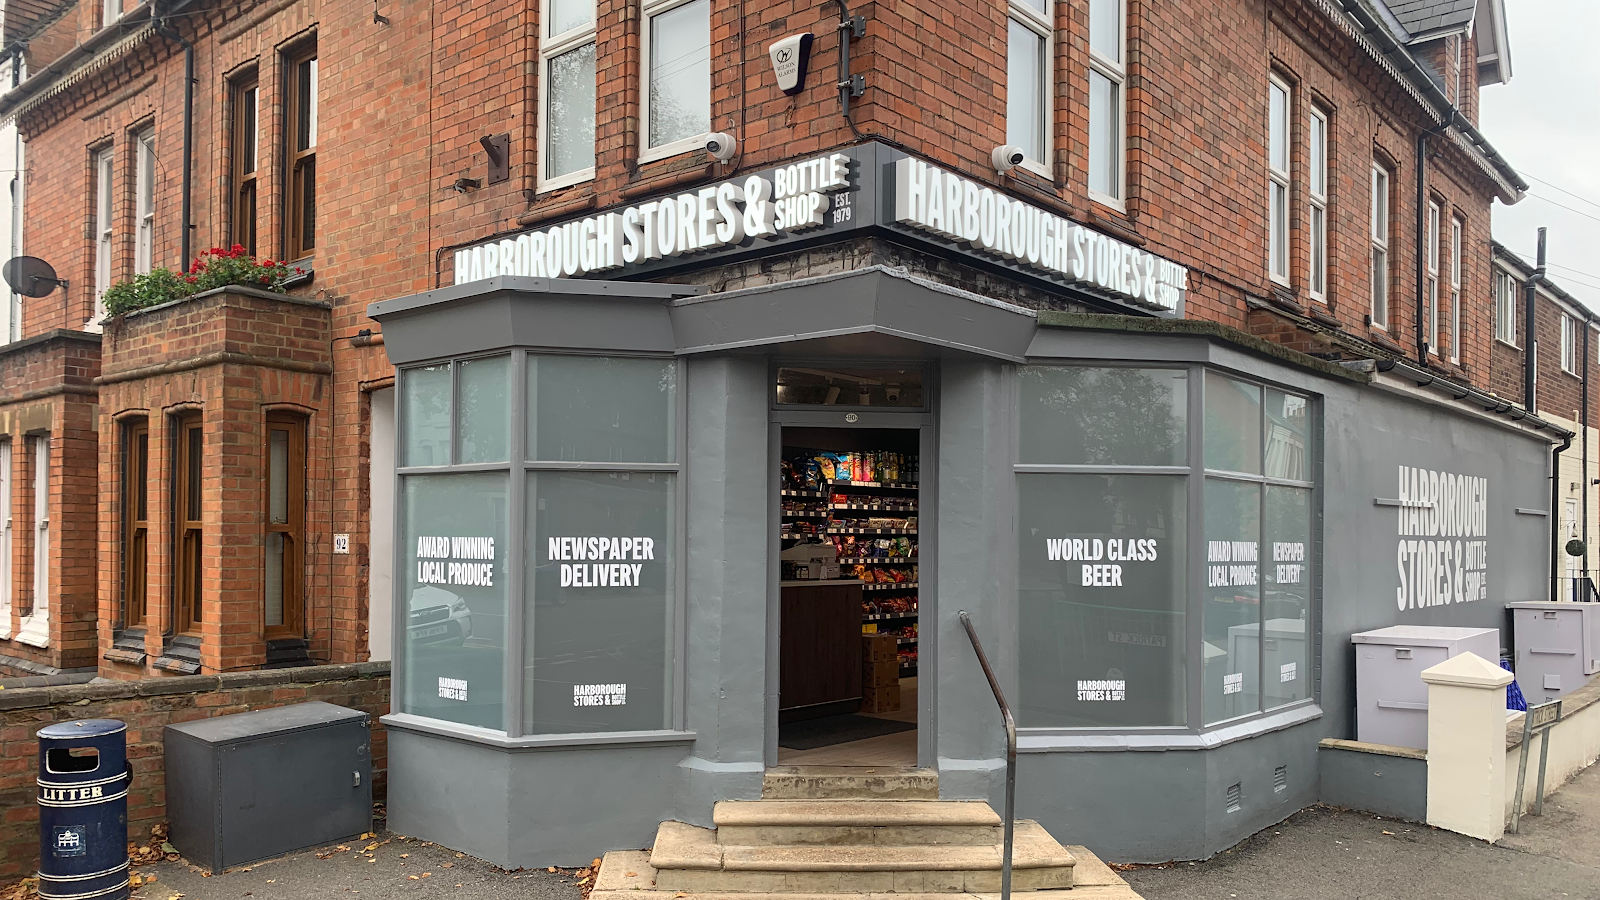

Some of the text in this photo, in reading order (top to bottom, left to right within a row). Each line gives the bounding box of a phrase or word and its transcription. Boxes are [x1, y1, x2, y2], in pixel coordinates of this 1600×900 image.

[775, 153, 846, 199] BOTTLE
[775, 192, 824, 230] SHOP
[835, 192, 851, 208] EST.
[833, 207, 851, 223] 1979
[455, 175, 772, 285] HARBOROUGH STORES &
[902, 157, 1157, 304] HARBOROUGH STORES &
[1160, 258, 1188, 290] BOTTLE
[1160, 283, 1180, 310] SHOP
[1398, 465, 1487, 537] HARBOROUGH
[336, 538, 346, 549] 92
[417, 536, 494, 560] AWARD WINNING
[548, 537, 654, 560] NEWSPAPER
[1047, 539, 1157, 561] WORLD CLASS
[1208, 541, 1258, 562] AWARD WINNING
[1273, 542, 1304, 562] NEWSPAPER
[1466, 541, 1486, 570] BOTTLE
[417, 561, 494, 586] LOCAL PRODUCE
[560, 564, 642, 587] DELIVERY
[1082, 565, 1122, 587] BEER
[1208, 565, 1257, 588] LOCAL PRODUCE
[1276, 565, 1300, 584] DELIVERY
[1397, 540, 1464, 611] STORES &
[1466, 572, 1480, 602] SHOP
[573, 683, 626, 695] HARBOROUGH
[1077, 680, 1125, 690] HARBOROUGH
[1077, 690, 1104, 701] STORES
[1105, 690, 1111, 701] &
[573, 695, 603, 706] STORES
[604, 695, 611, 706] &
[43, 786, 103, 801] LITTER
